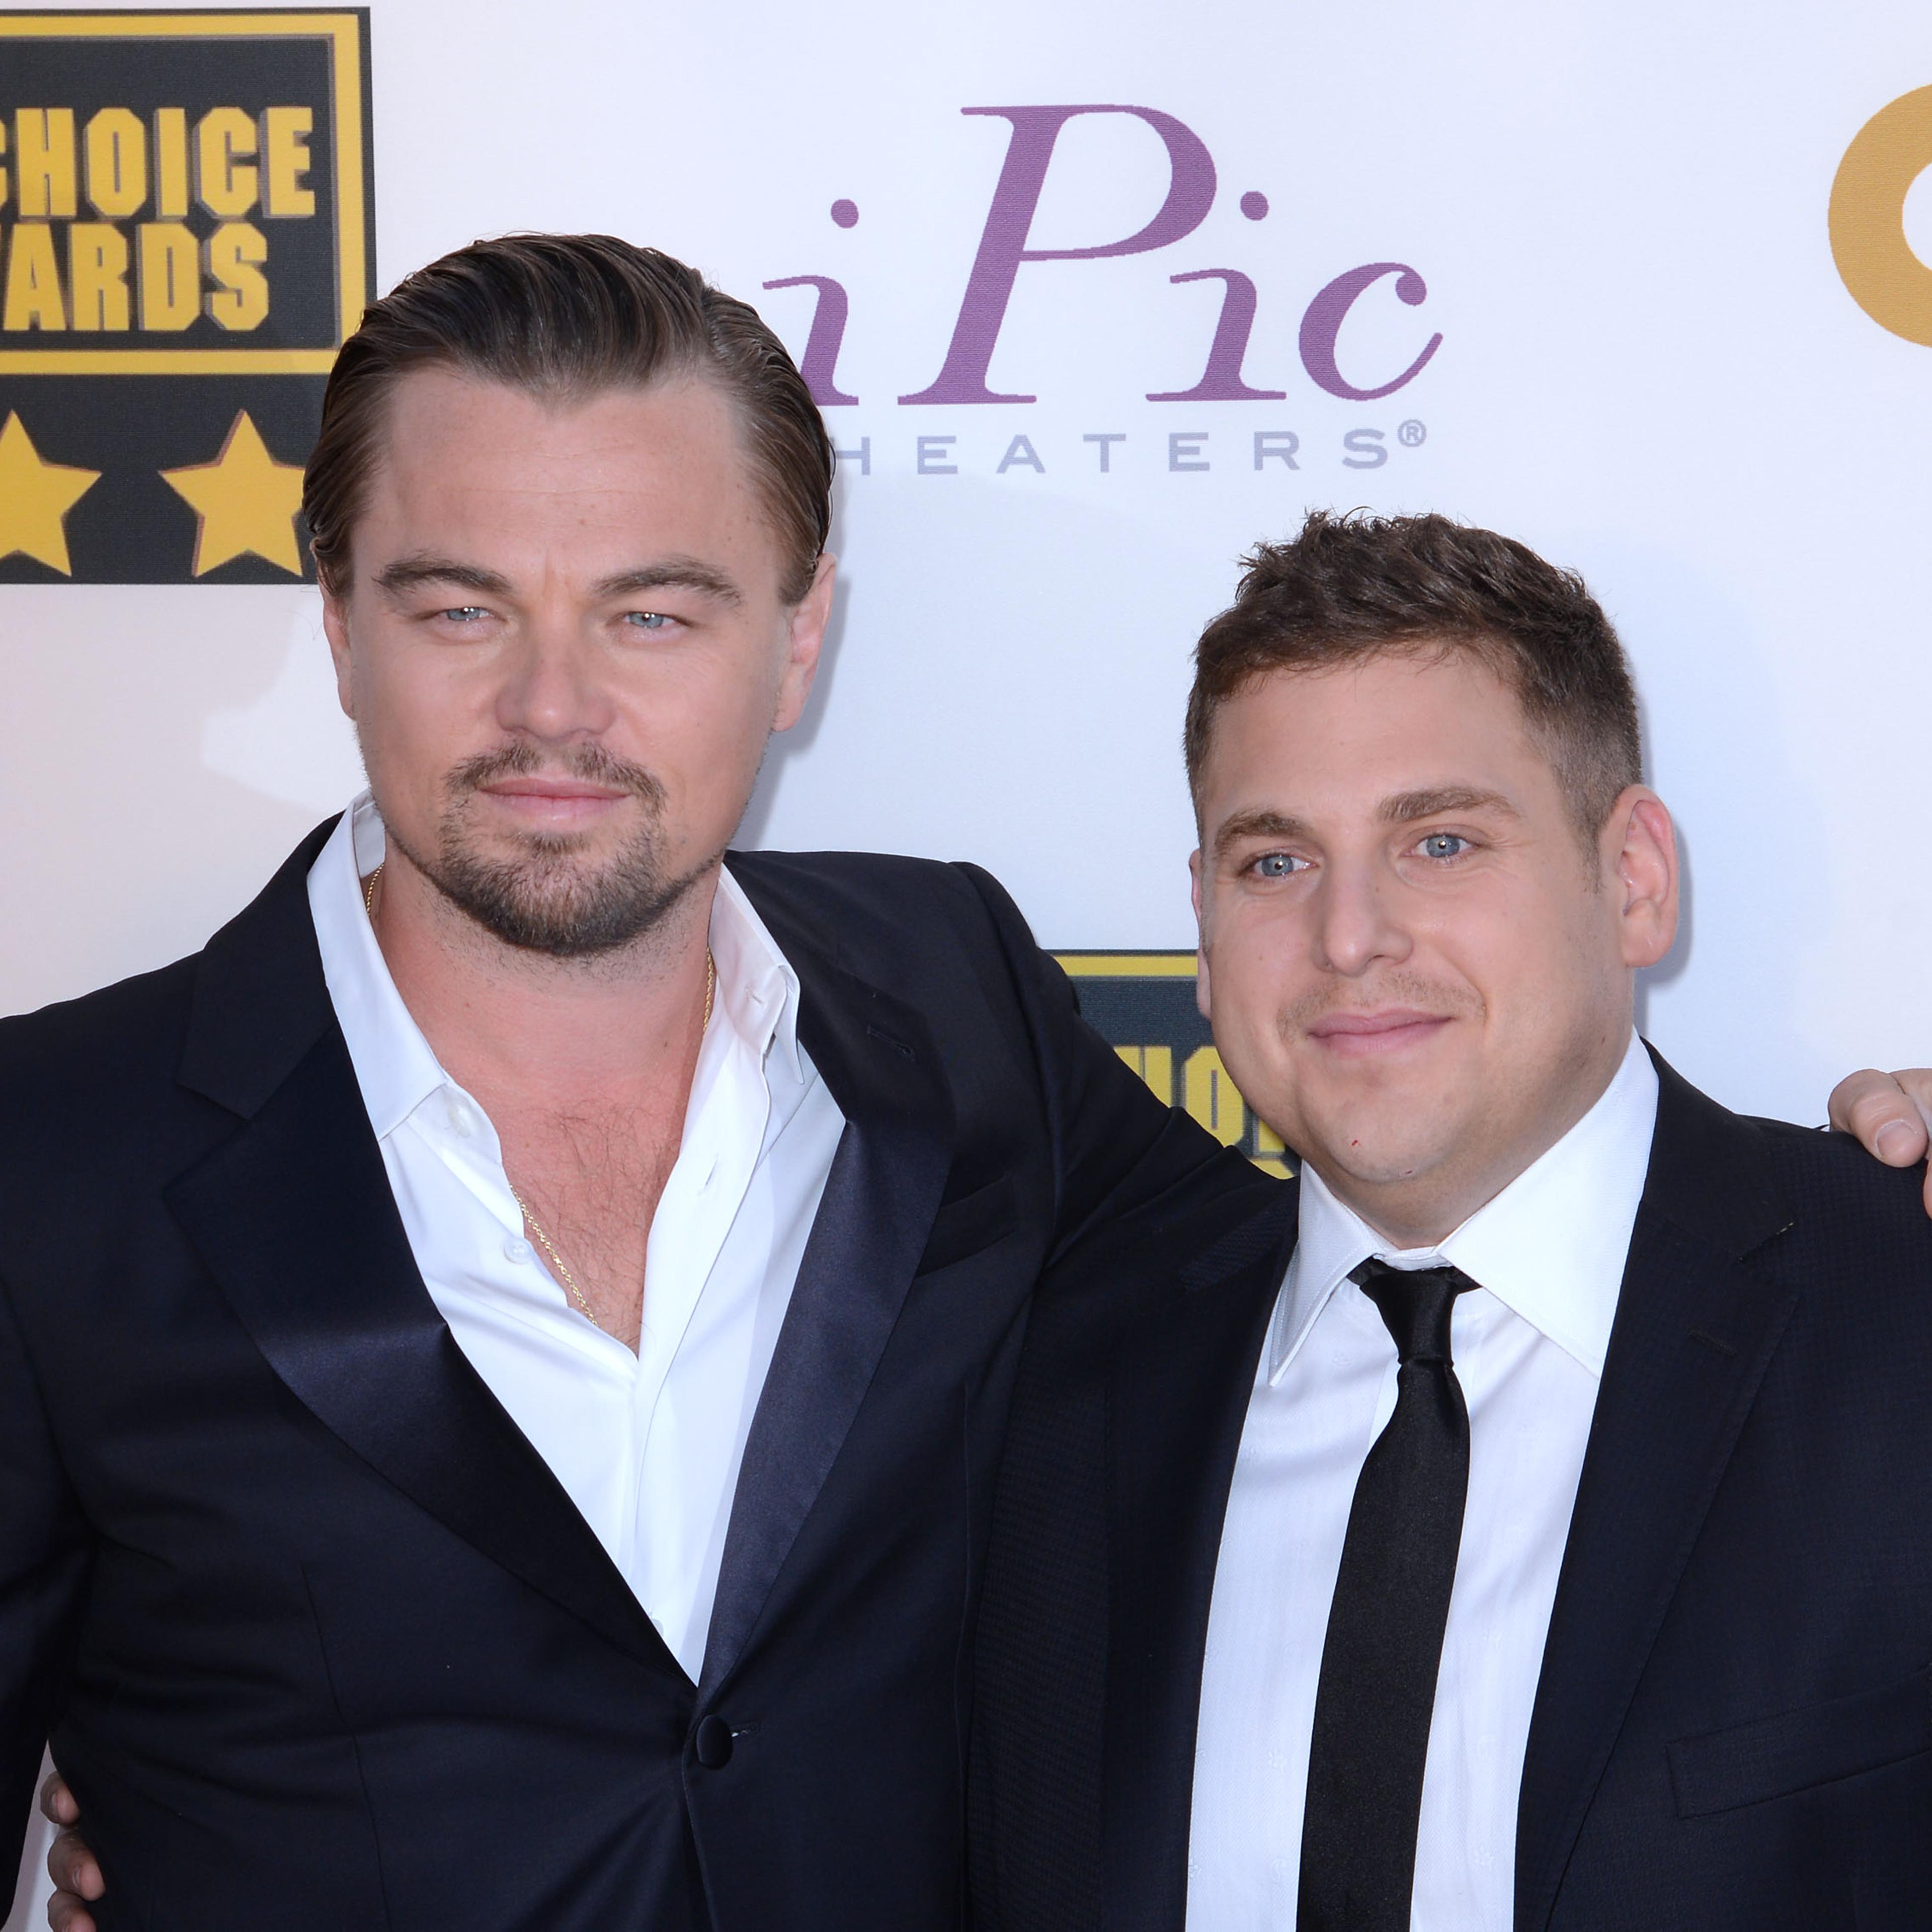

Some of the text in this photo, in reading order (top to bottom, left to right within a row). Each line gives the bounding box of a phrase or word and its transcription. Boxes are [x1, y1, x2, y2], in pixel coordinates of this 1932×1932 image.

[0, 106, 315, 218] HOICE
[0, 221, 269, 332] ARDS
[762, 104, 1443, 406] iPic
